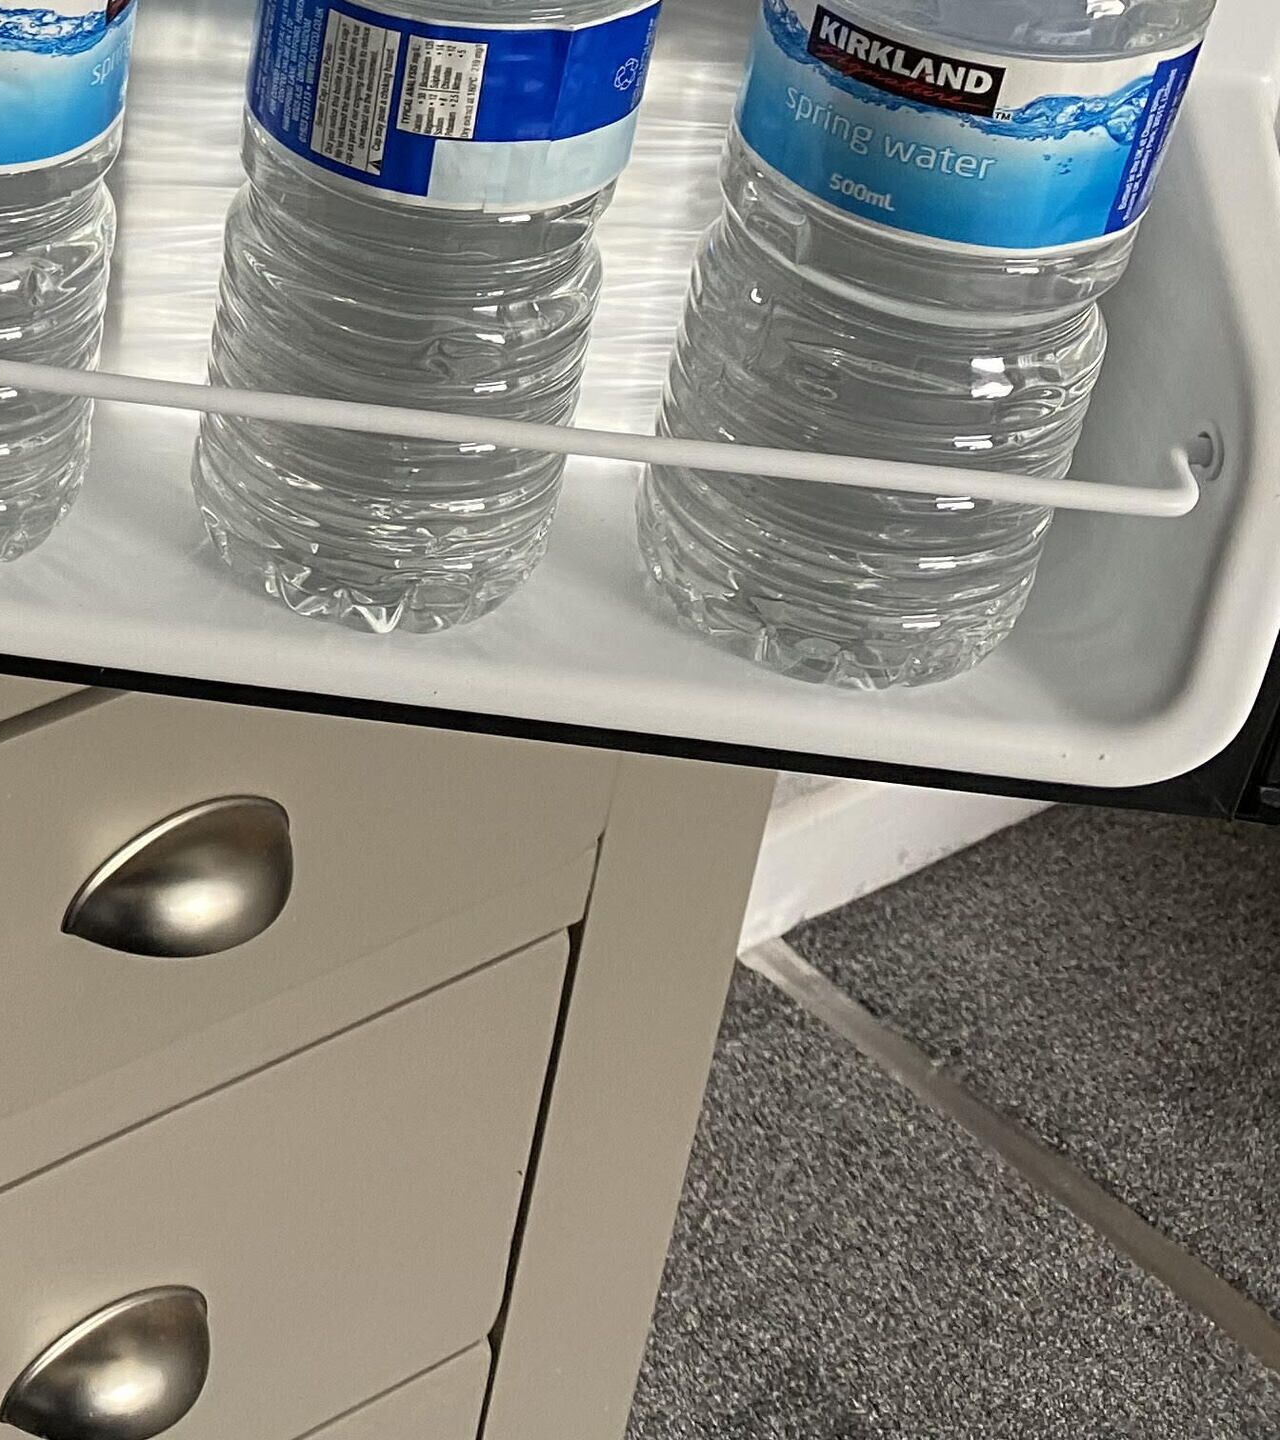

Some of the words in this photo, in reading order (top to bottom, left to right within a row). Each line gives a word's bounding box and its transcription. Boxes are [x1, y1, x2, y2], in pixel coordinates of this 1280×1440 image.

[819, 15, 993, 94] KIRKLAND
[404, 63, 417, 97] ANALYSIS
[401, 98, 412, 123] TYPICAL
[785, 86, 873, 155] spring
[884, 135, 996, 180] water
[829, 173, 896, 211] 500mL
